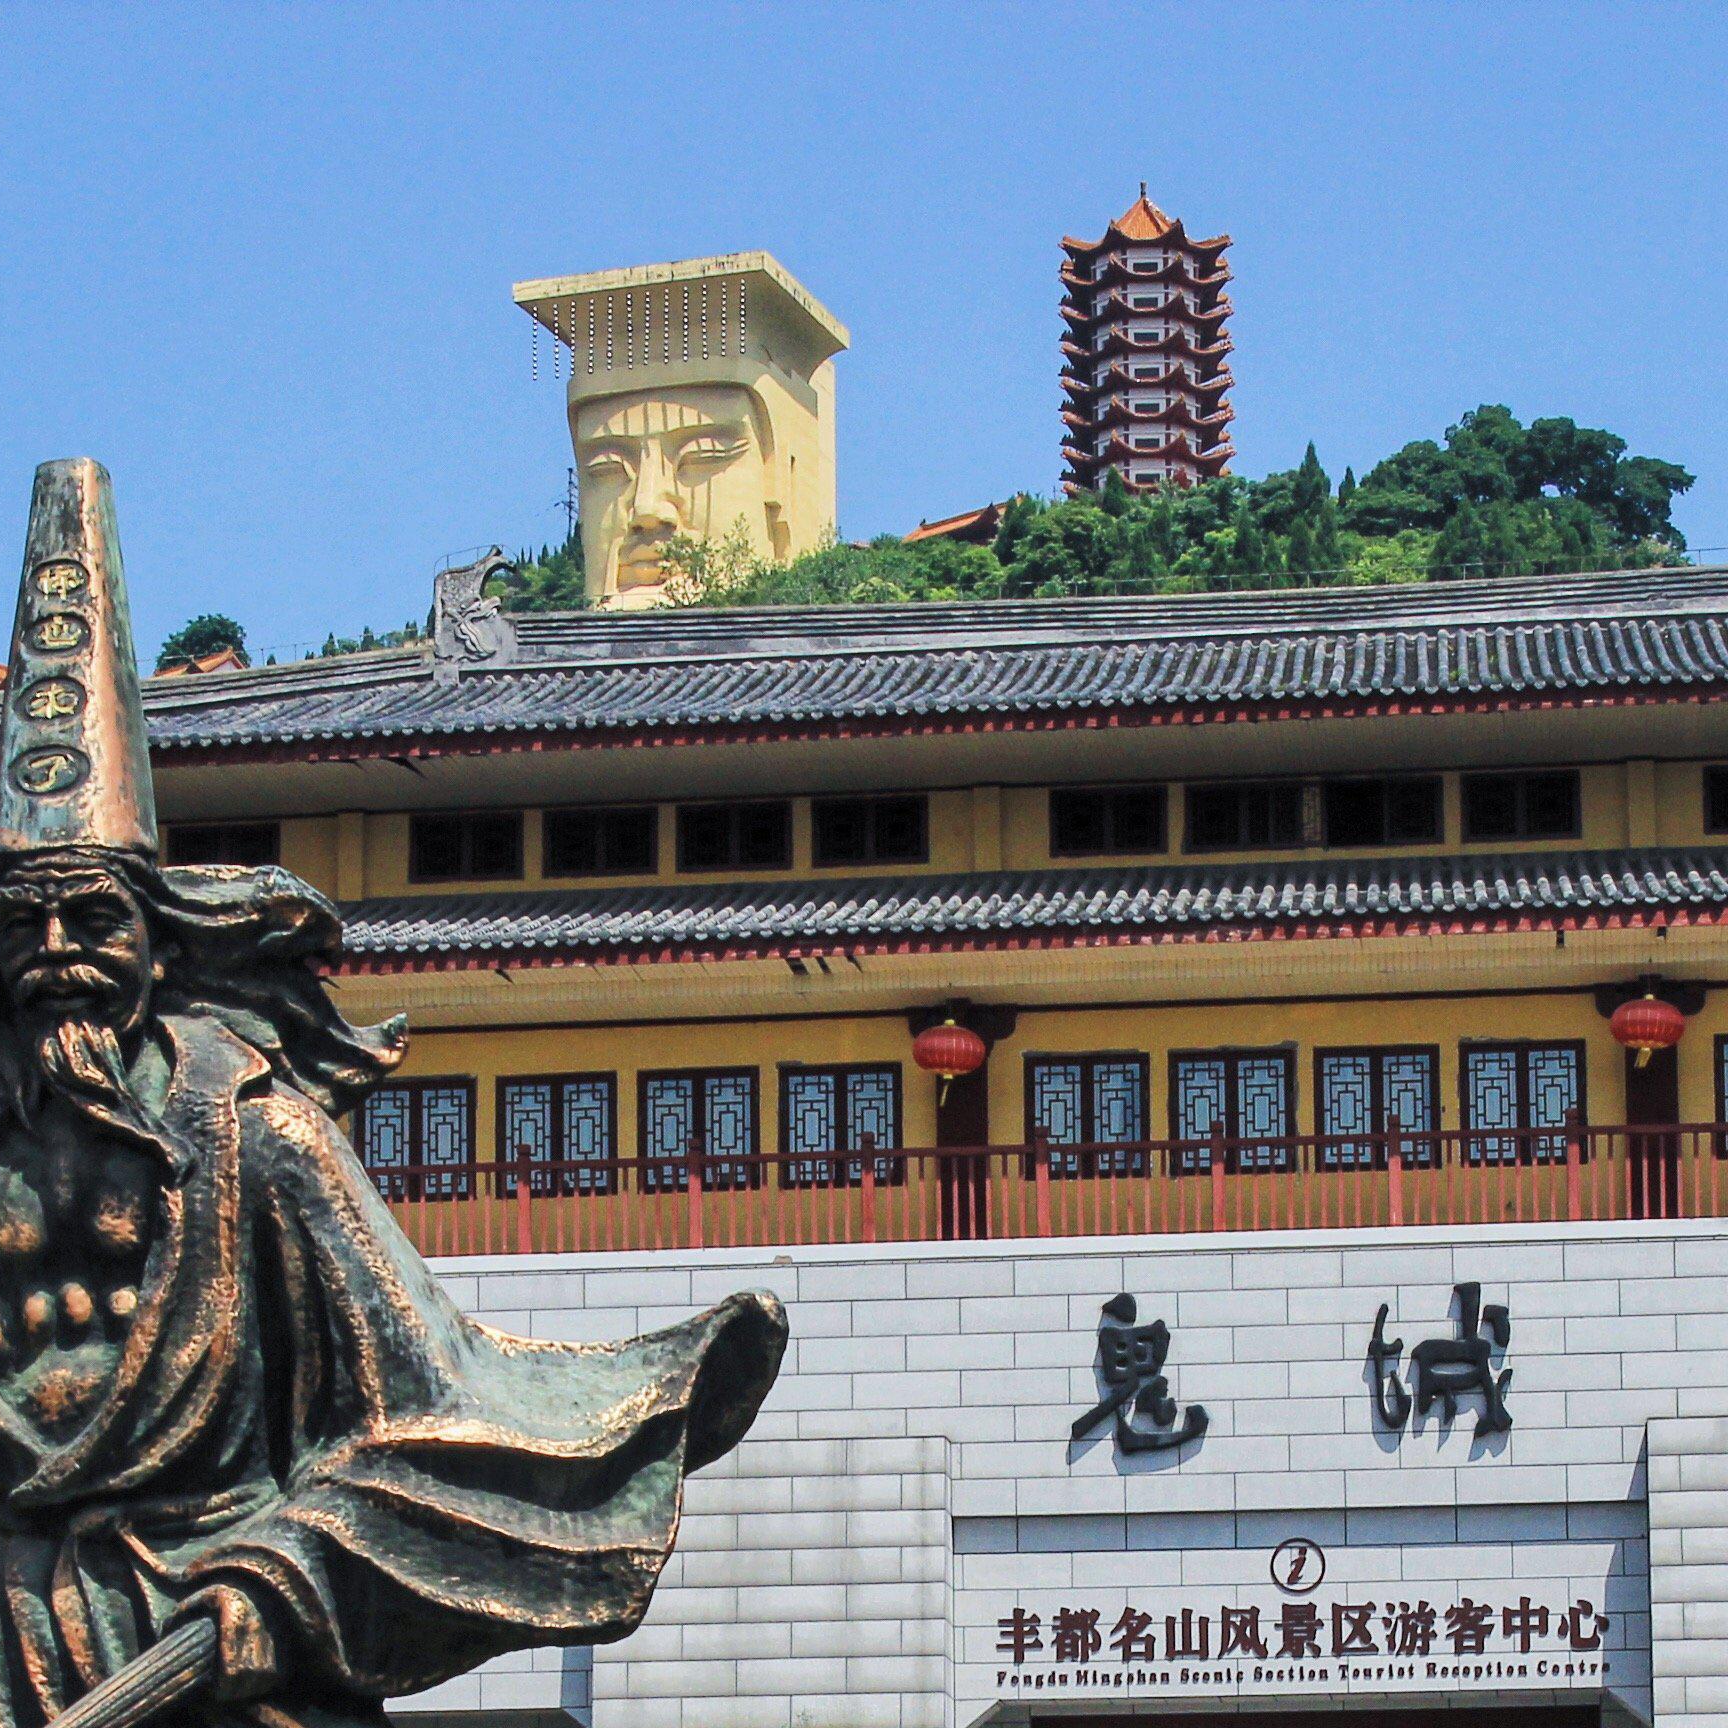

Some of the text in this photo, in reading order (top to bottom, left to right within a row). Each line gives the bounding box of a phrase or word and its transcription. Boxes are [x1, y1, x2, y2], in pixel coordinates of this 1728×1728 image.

[1071, 1281, 1513, 1453] 鬼城
[995, 1596, 1610, 1664] 丰都名山风景区游客中心
[996, 1659, 1611, 1689] Fengdu Mingshan Scenic Section Tourist Reception Centre
